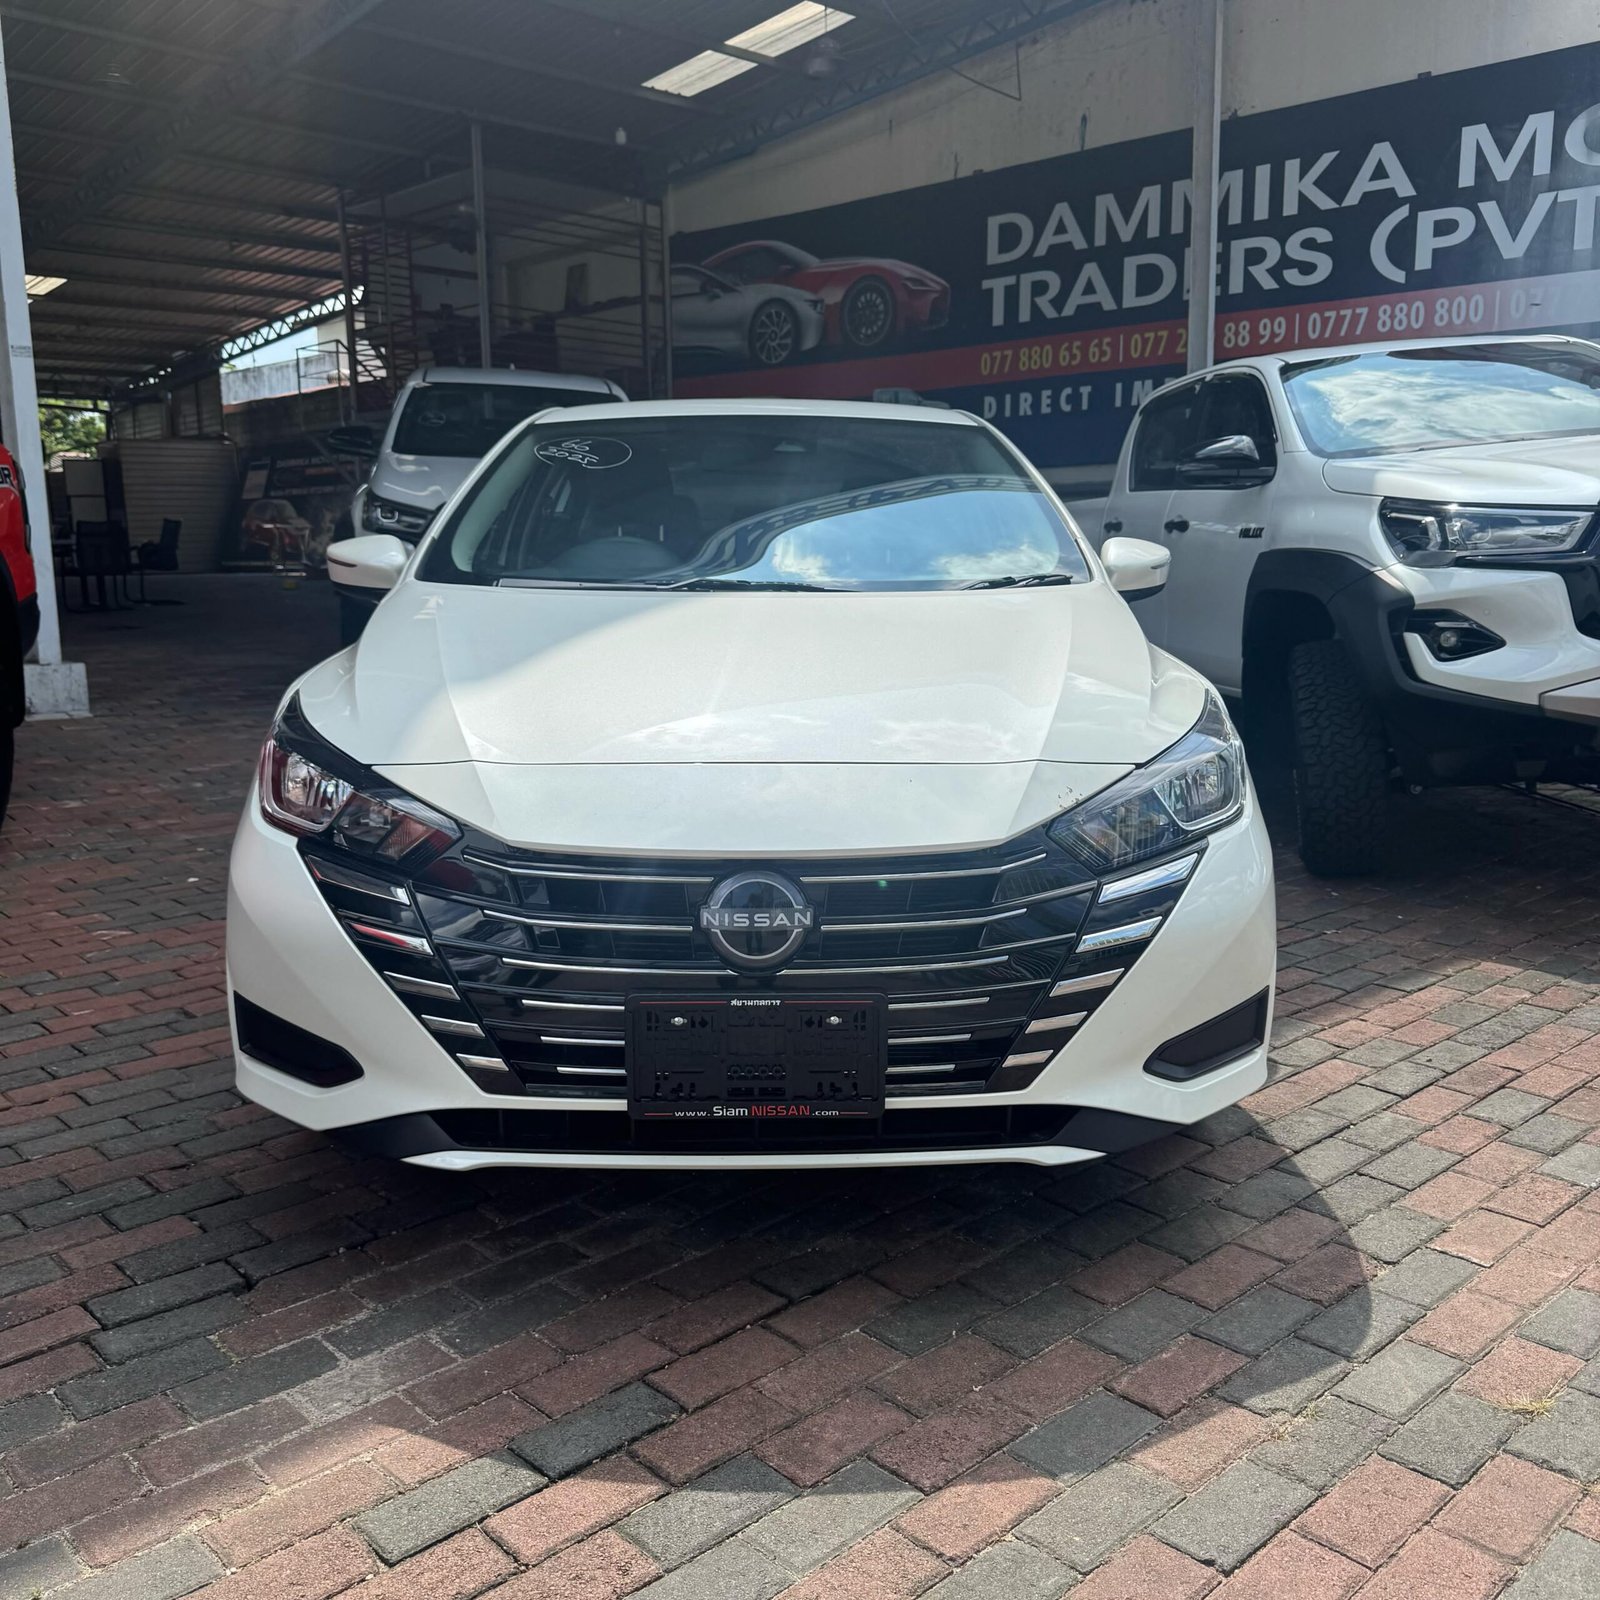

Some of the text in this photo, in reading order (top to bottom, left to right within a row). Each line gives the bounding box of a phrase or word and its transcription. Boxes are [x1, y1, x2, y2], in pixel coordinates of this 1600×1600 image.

[986, 140, 1417, 266] DAMMIKA
[981, 350, 1013, 376] 077
[1018, 345, 1053, 372] 880
[1059, 341, 1081, 367] 65
[1088, 337, 1112, 364] 65
[1130, 330, 1170, 359] 077
[1223, 320, 1251, 349] 88
[1258, 316, 1287, 345] 99
[1307, 306, 1370, 340] 0777
[1376, 302, 1426, 333] 880
[1433, 294, 1485, 327] 800
[983, 384, 1093, 420] DIRECT
[702, 910, 812, 928] NISSAN
